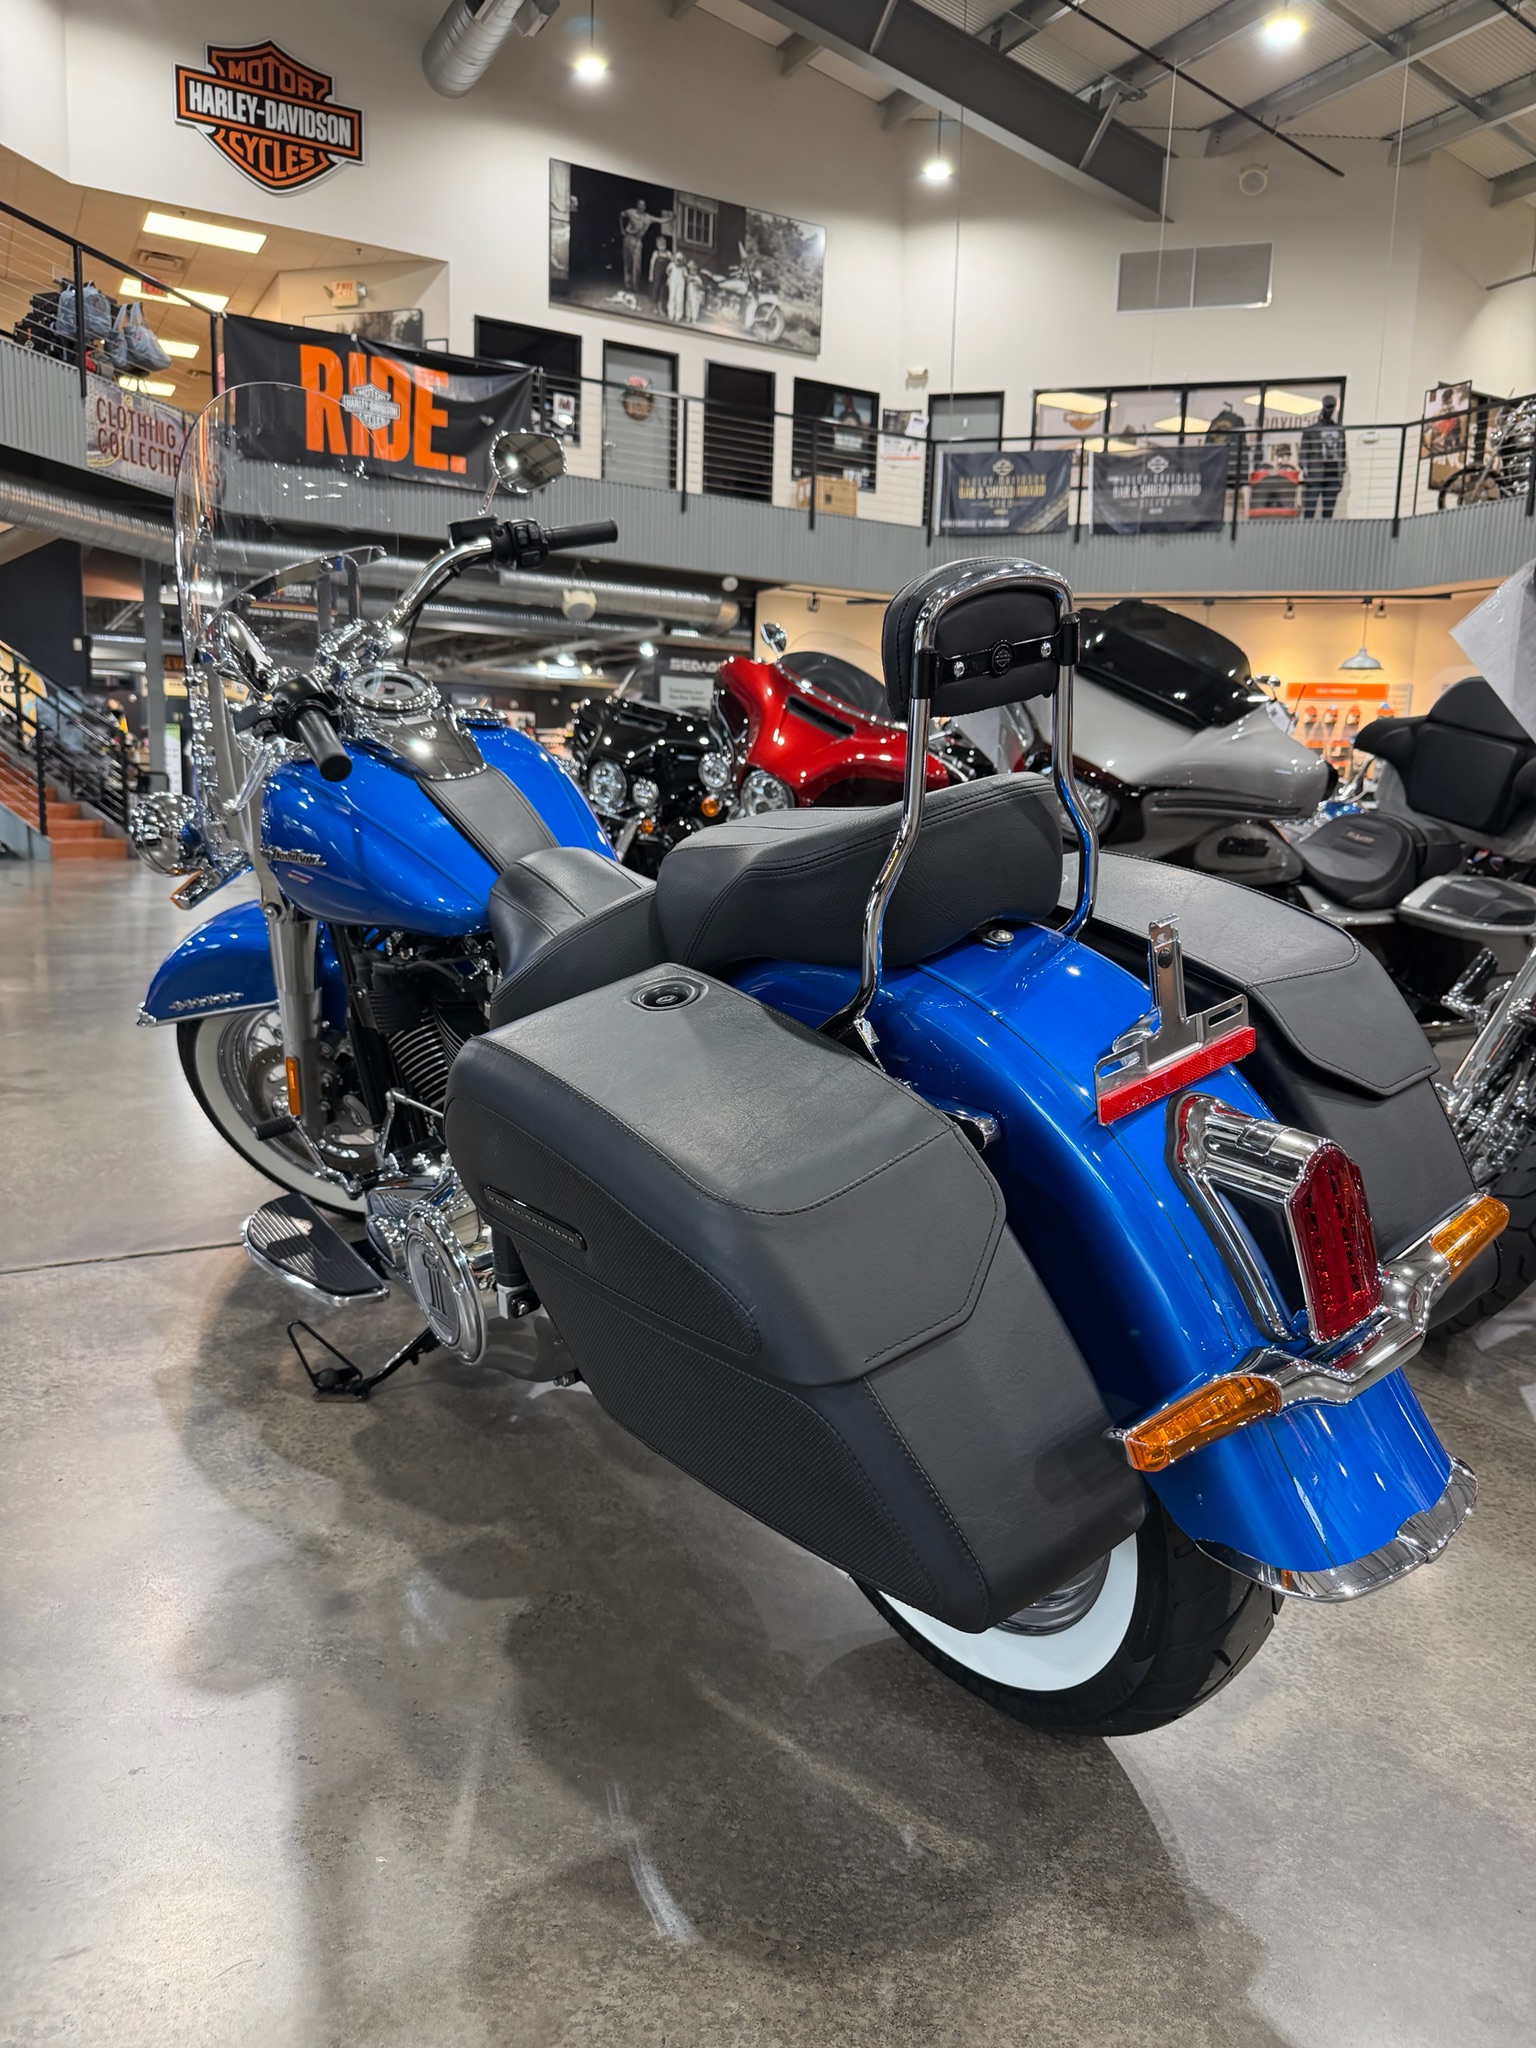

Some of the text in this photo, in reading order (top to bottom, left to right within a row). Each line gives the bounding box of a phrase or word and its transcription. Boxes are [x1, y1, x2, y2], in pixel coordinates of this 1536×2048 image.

[227, 58, 314, 99] MOTOR
[188, 80, 351, 148] HARLEY-DAVIDSON
[228, 130, 315, 179] CYCLES
[96, 397, 176, 449] CLOTHING
